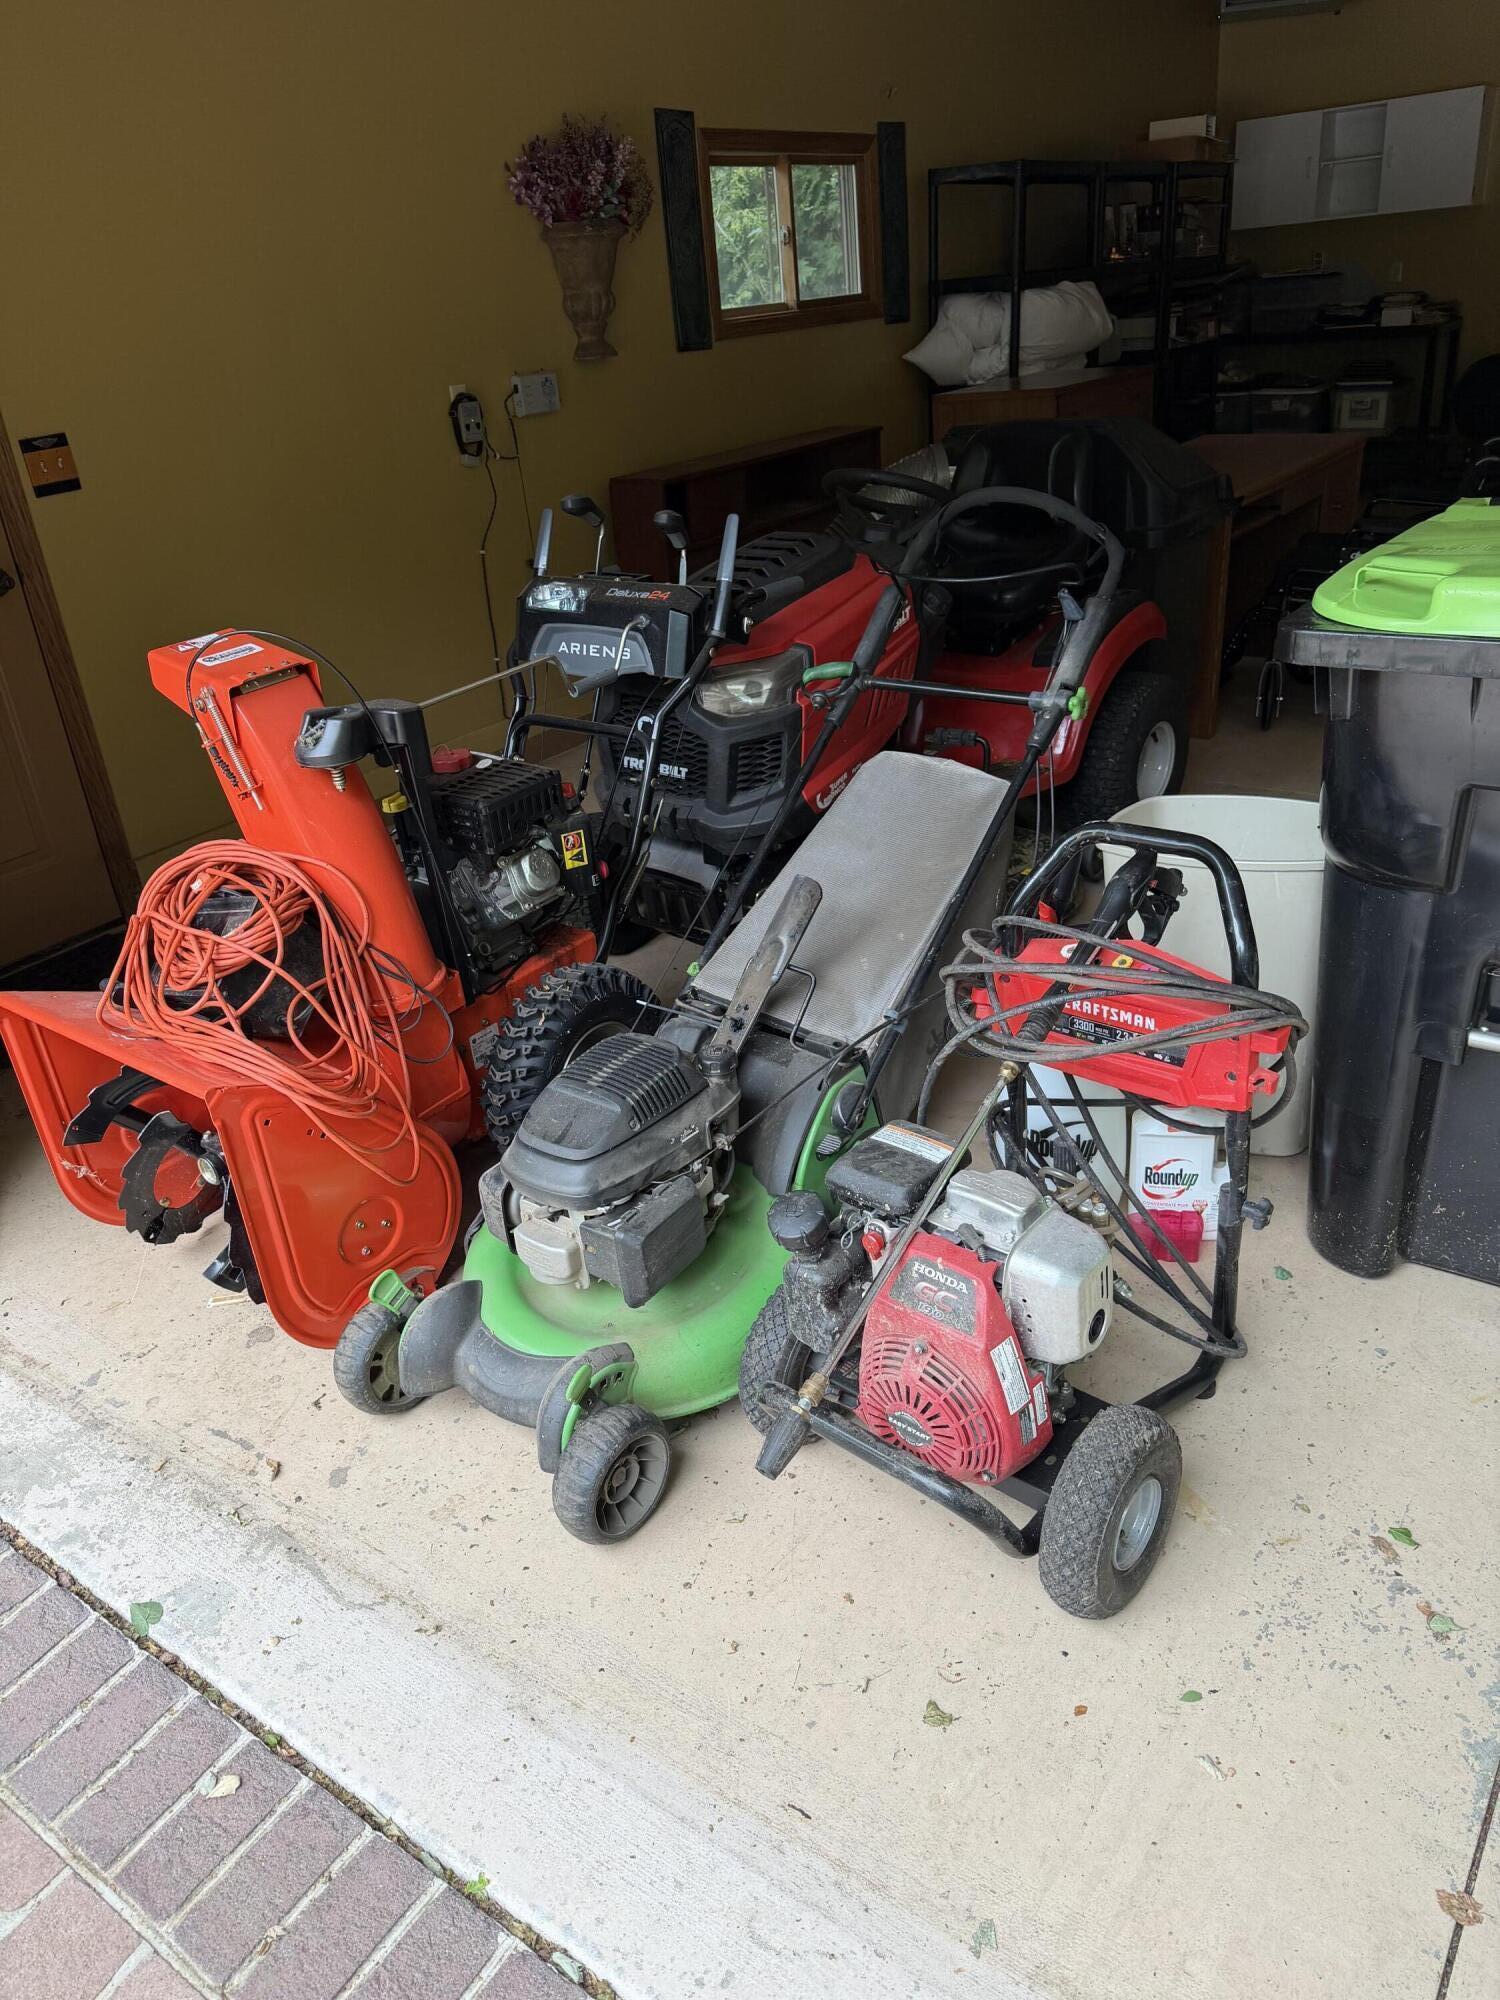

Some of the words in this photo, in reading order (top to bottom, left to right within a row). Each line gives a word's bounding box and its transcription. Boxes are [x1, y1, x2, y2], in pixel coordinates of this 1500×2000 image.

[558, 641, 631, 660] ARIENS
[623, 756, 689, 780] TRBILT
[1073, 1018, 1095, 1033] 3300
[1027, 1129, 1098, 1163] Roup
[1144, 1166, 1200, 1190] Roundup
[912, 1261, 969, 1294] HONDA
